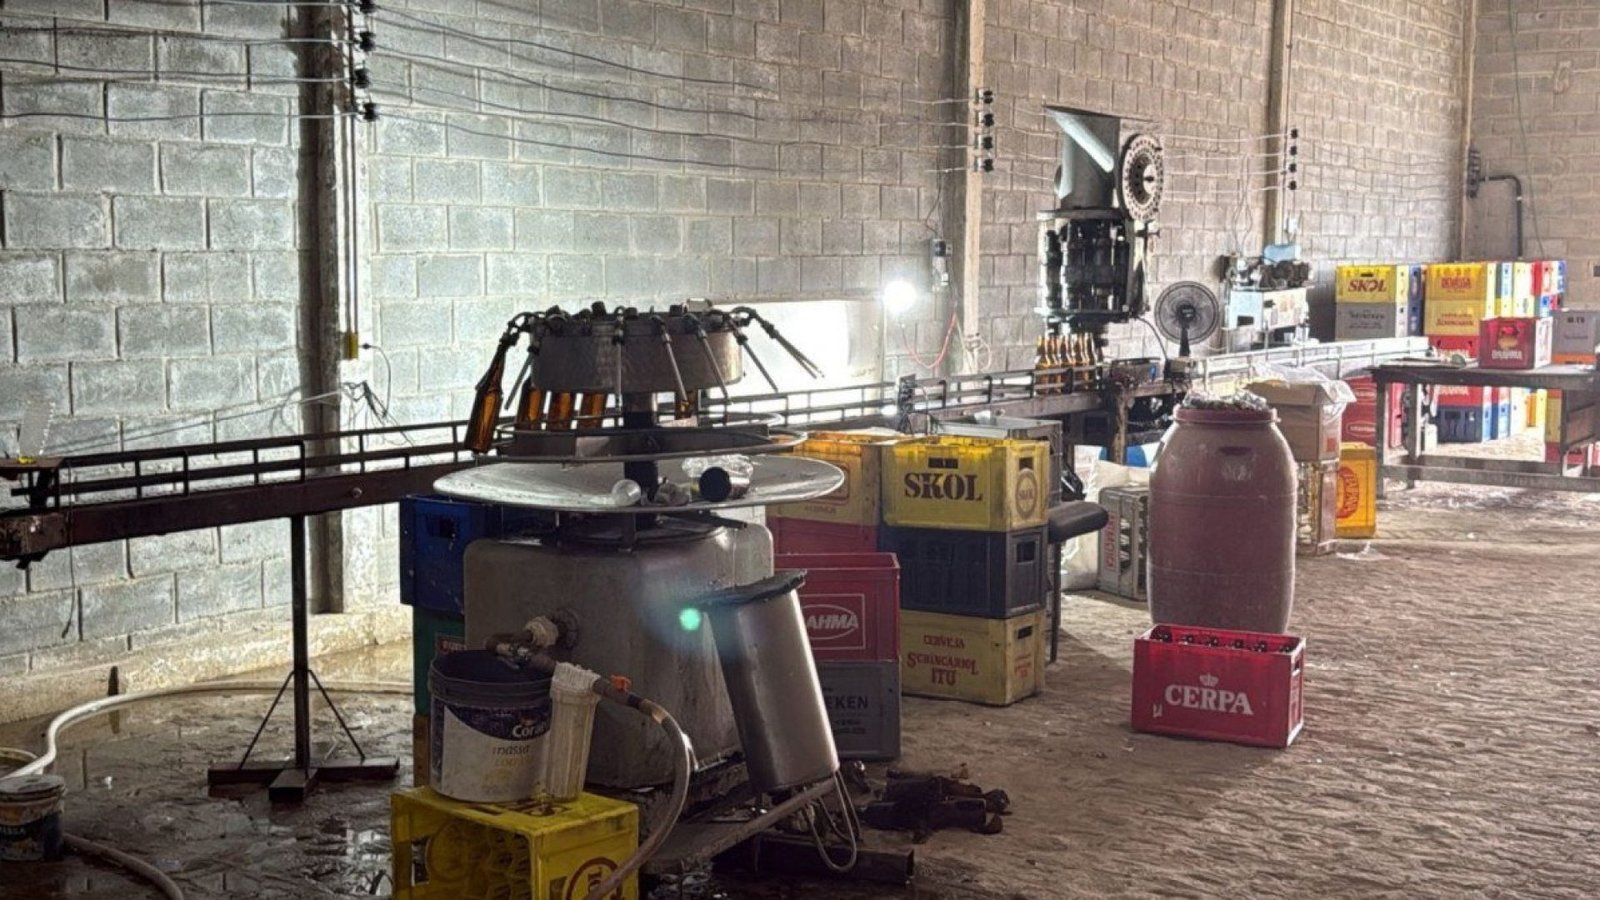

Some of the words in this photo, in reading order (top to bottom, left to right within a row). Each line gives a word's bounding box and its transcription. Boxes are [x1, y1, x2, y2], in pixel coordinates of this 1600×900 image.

[1347, 279, 1387, 292] SKOL
[904, 472, 983, 501] SKOL
[807, 614, 859, 629] AHMA
[924, 634, 965, 649] CERVEJA
[931, 667, 957, 686] ITU
[824, 695, 868, 710] EKEN
[1165, 684, 1253, 715] CERPA
